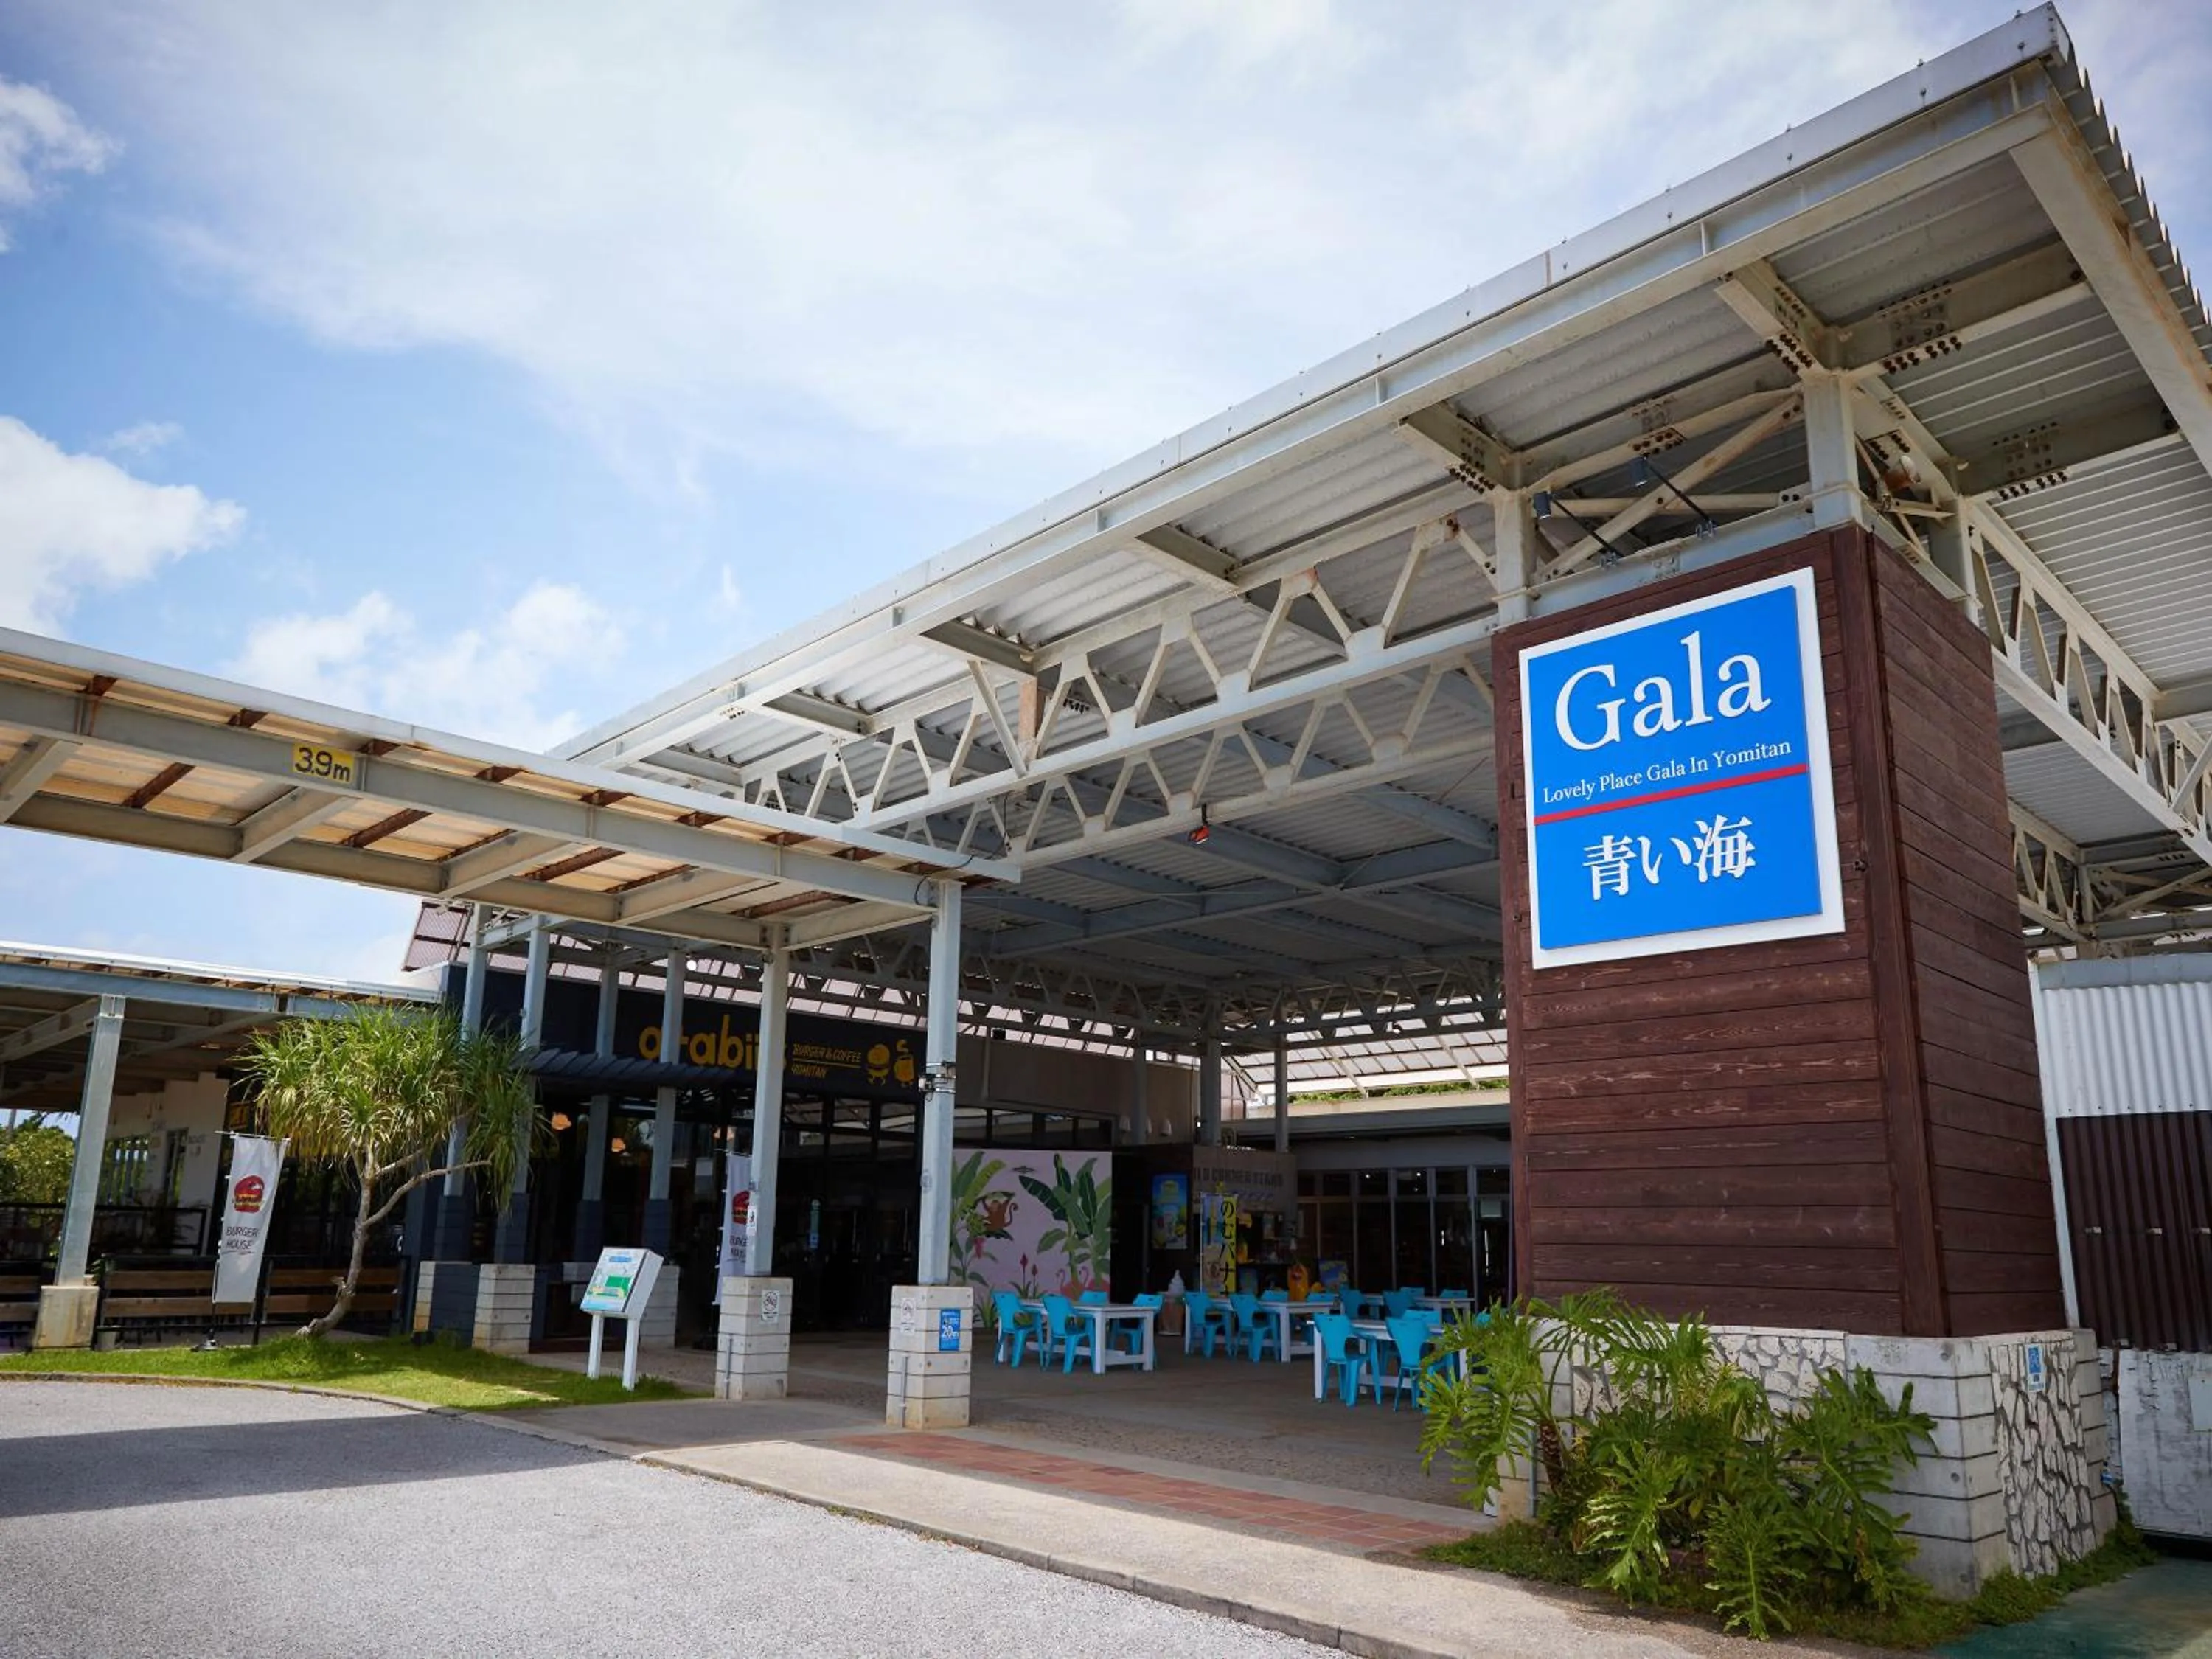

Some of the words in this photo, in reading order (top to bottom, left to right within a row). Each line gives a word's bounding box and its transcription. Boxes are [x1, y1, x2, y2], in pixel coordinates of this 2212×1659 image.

[1555, 630, 1772, 751] Gala
[296, 747, 350, 782] 3.9m
[1543, 779, 1596, 804] Lovely
[1599, 773, 1643, 793] Place
[1646, 760, 1686, 782] Gala
[1691, 757, 1709, 773] In
[1713, 741, 1792, 768] Yomitan
[1582, 814, 1756, 900] 青い海
[226, 1226, 258, 1238] BURGER
